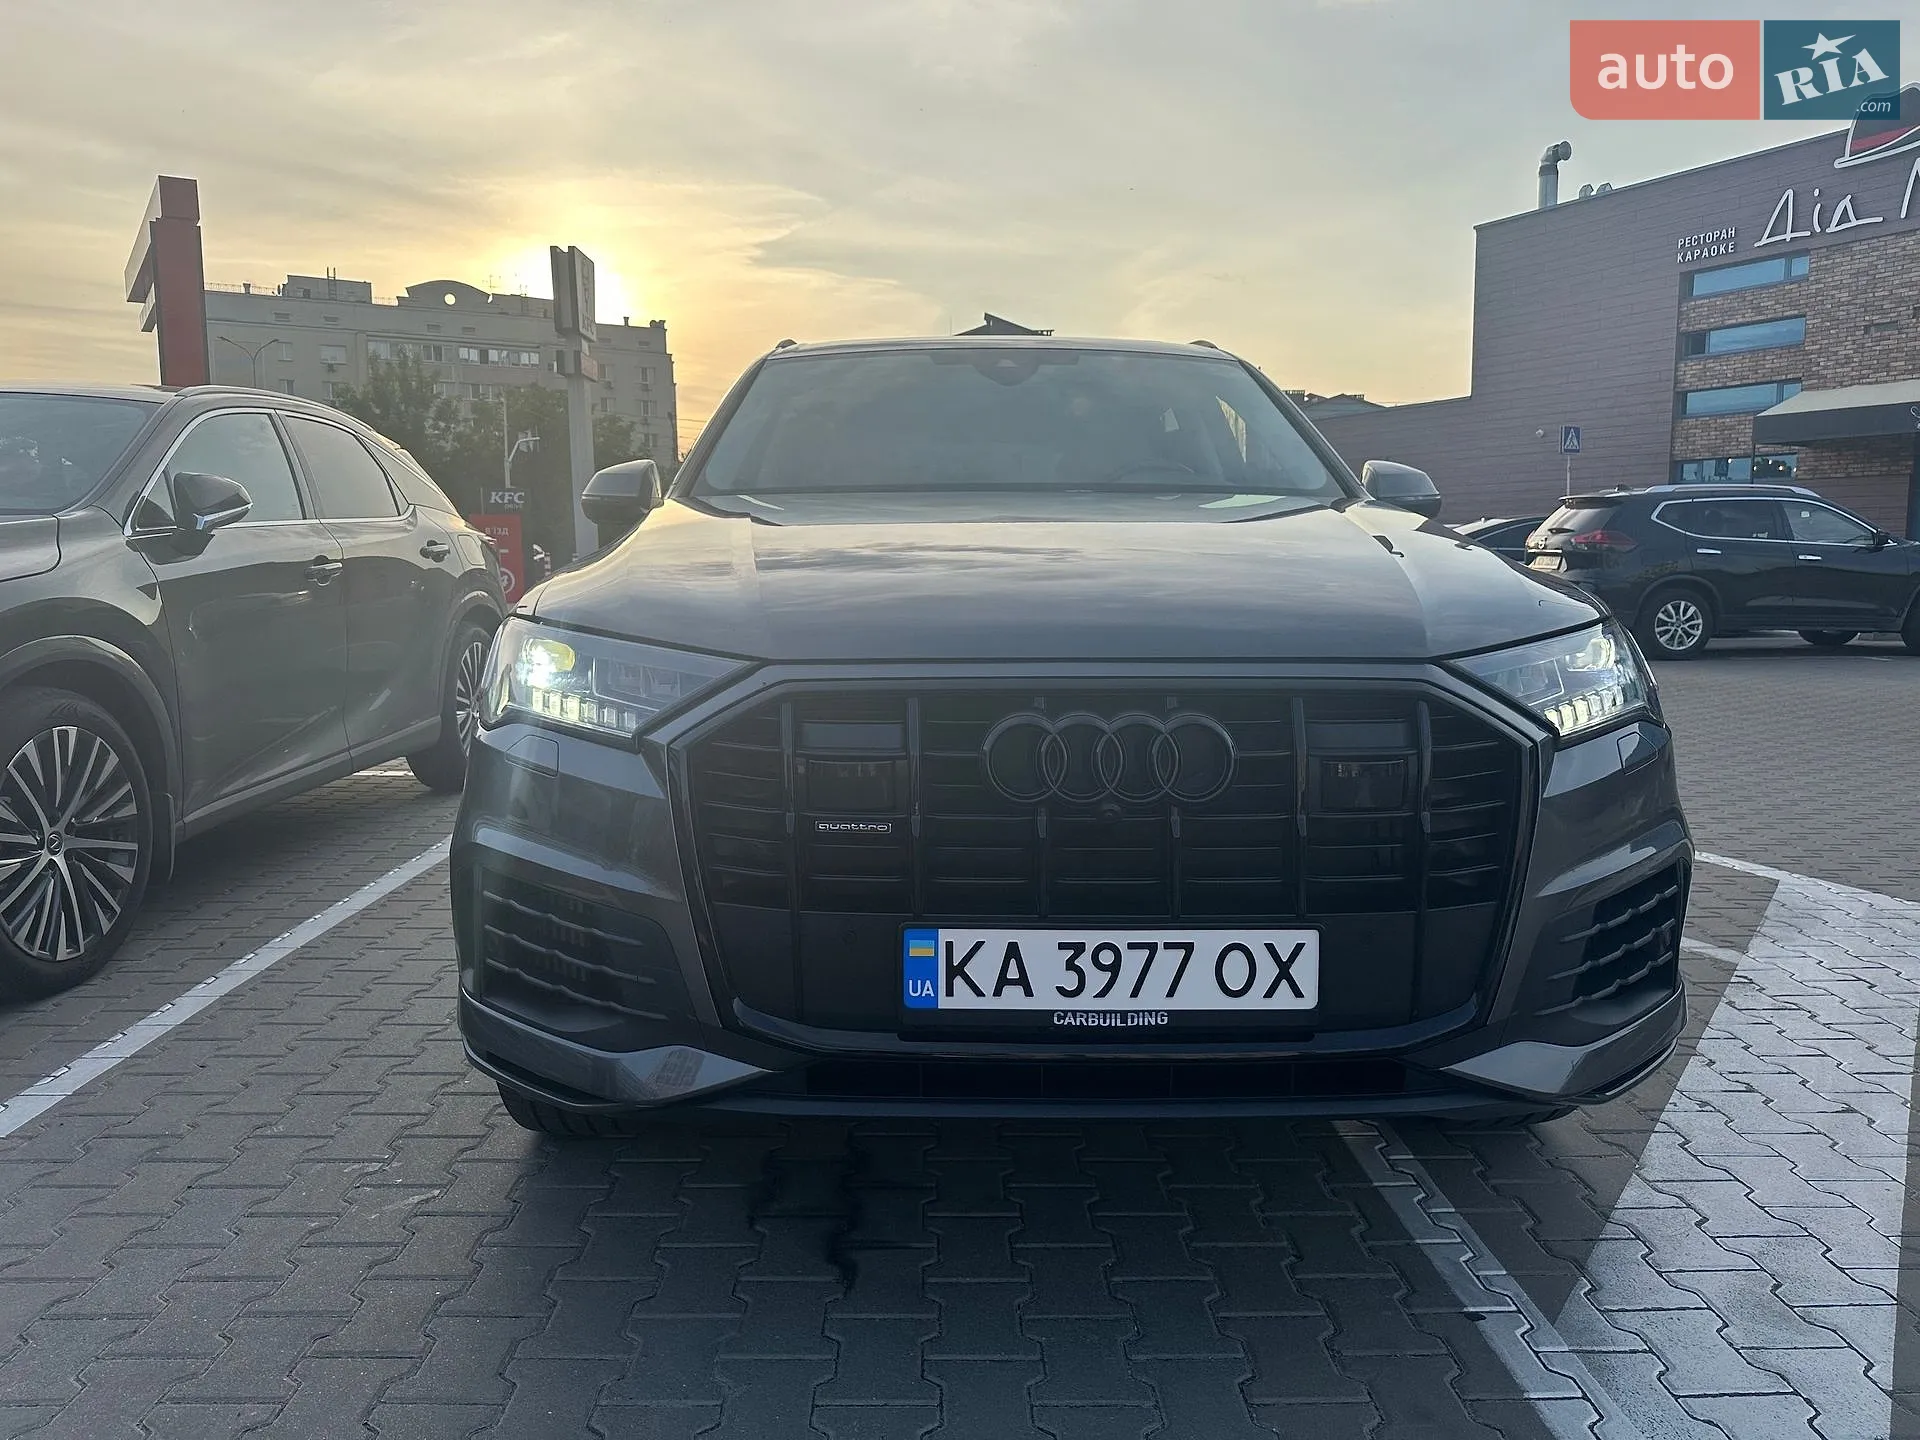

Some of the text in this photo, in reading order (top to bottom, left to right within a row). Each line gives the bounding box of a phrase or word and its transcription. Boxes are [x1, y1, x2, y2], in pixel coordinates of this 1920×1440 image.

[1677, 226, 1736, 249] РЕСТОРАН
[1677, 241, 1735, 264] КАРАОКЕ
[489, 491, 525, 504] KFC
[818, 822, 889, 831] quattro
[944, 940, 1307, 999] KA 3977 OX
[908, 979, 935, 997] UA
[1053, 1010, 1169, 1027] CARBUILDING
